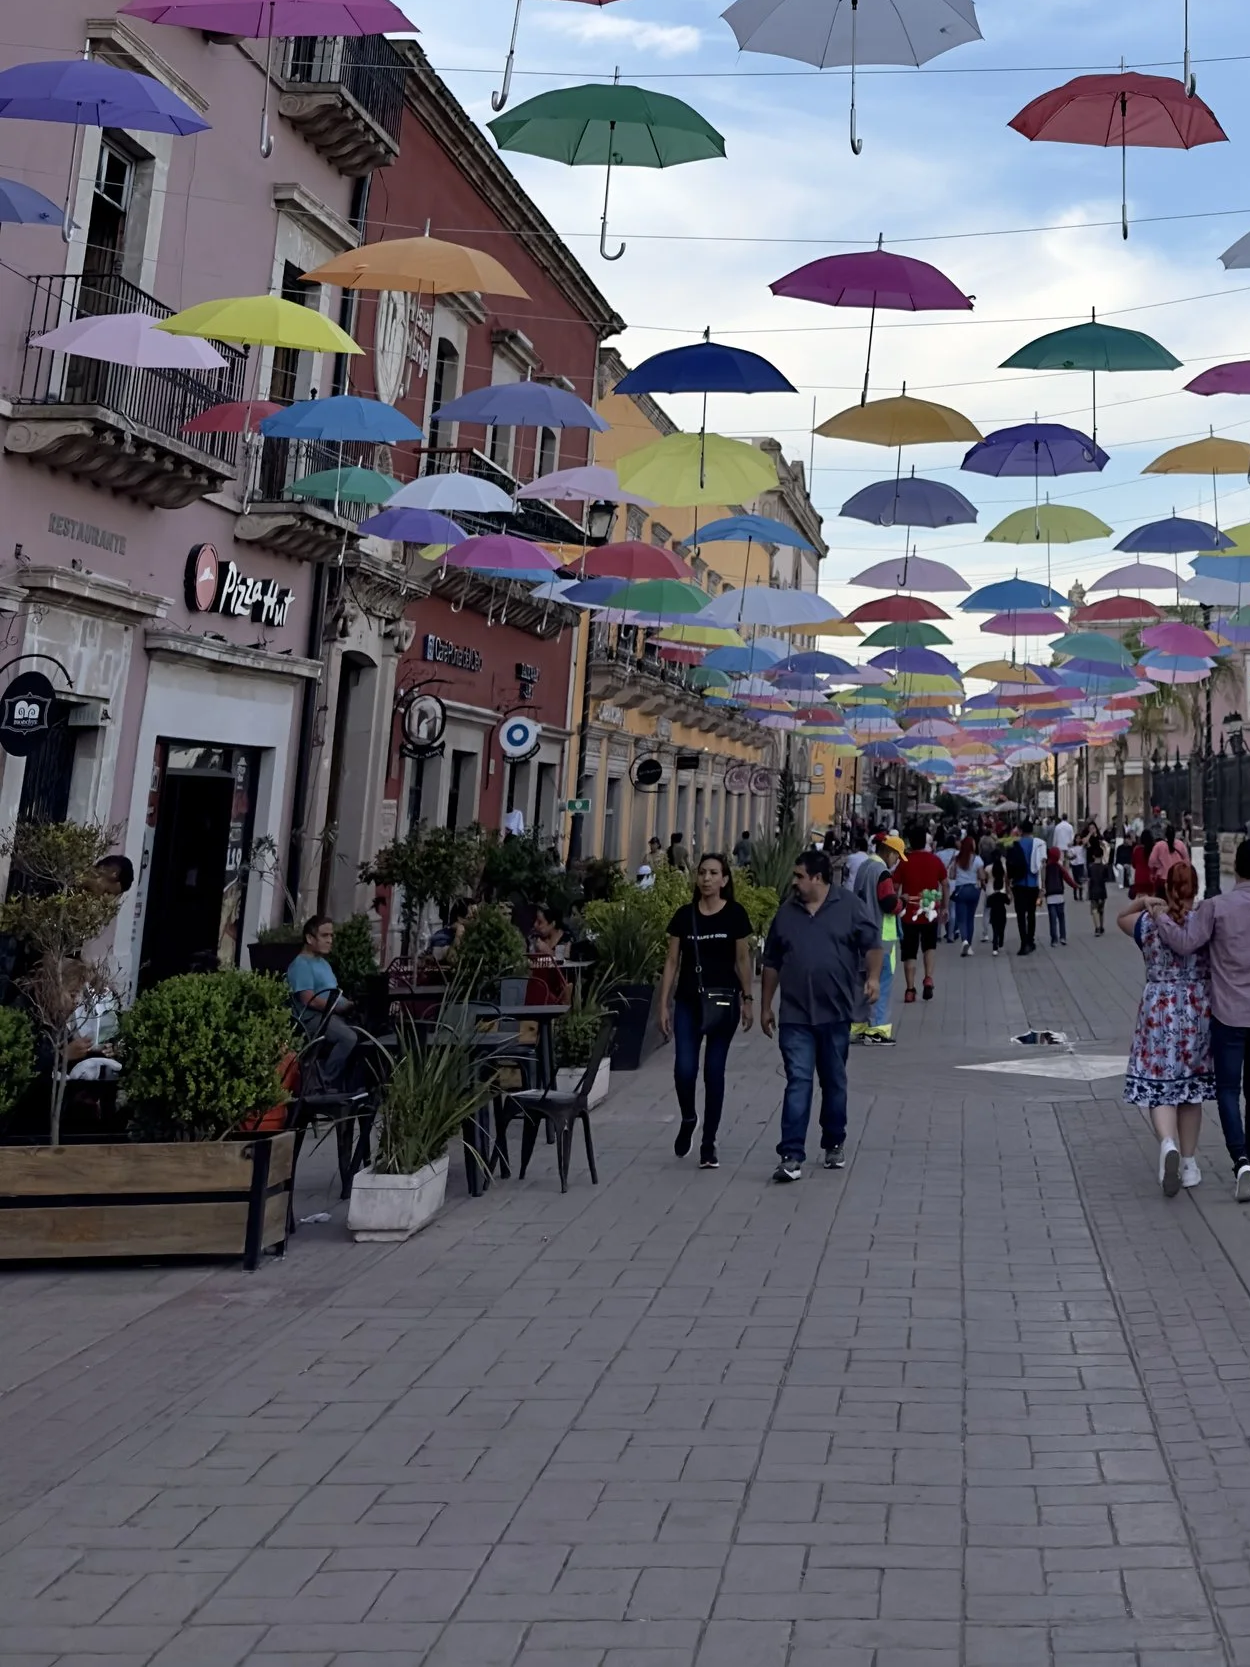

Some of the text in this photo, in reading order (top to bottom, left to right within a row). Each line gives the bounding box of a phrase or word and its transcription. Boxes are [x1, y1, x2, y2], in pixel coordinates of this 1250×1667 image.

[48, 512, 127, 556] RESTAURANTE
[219, 560, 296, 626] Pizza Hut
